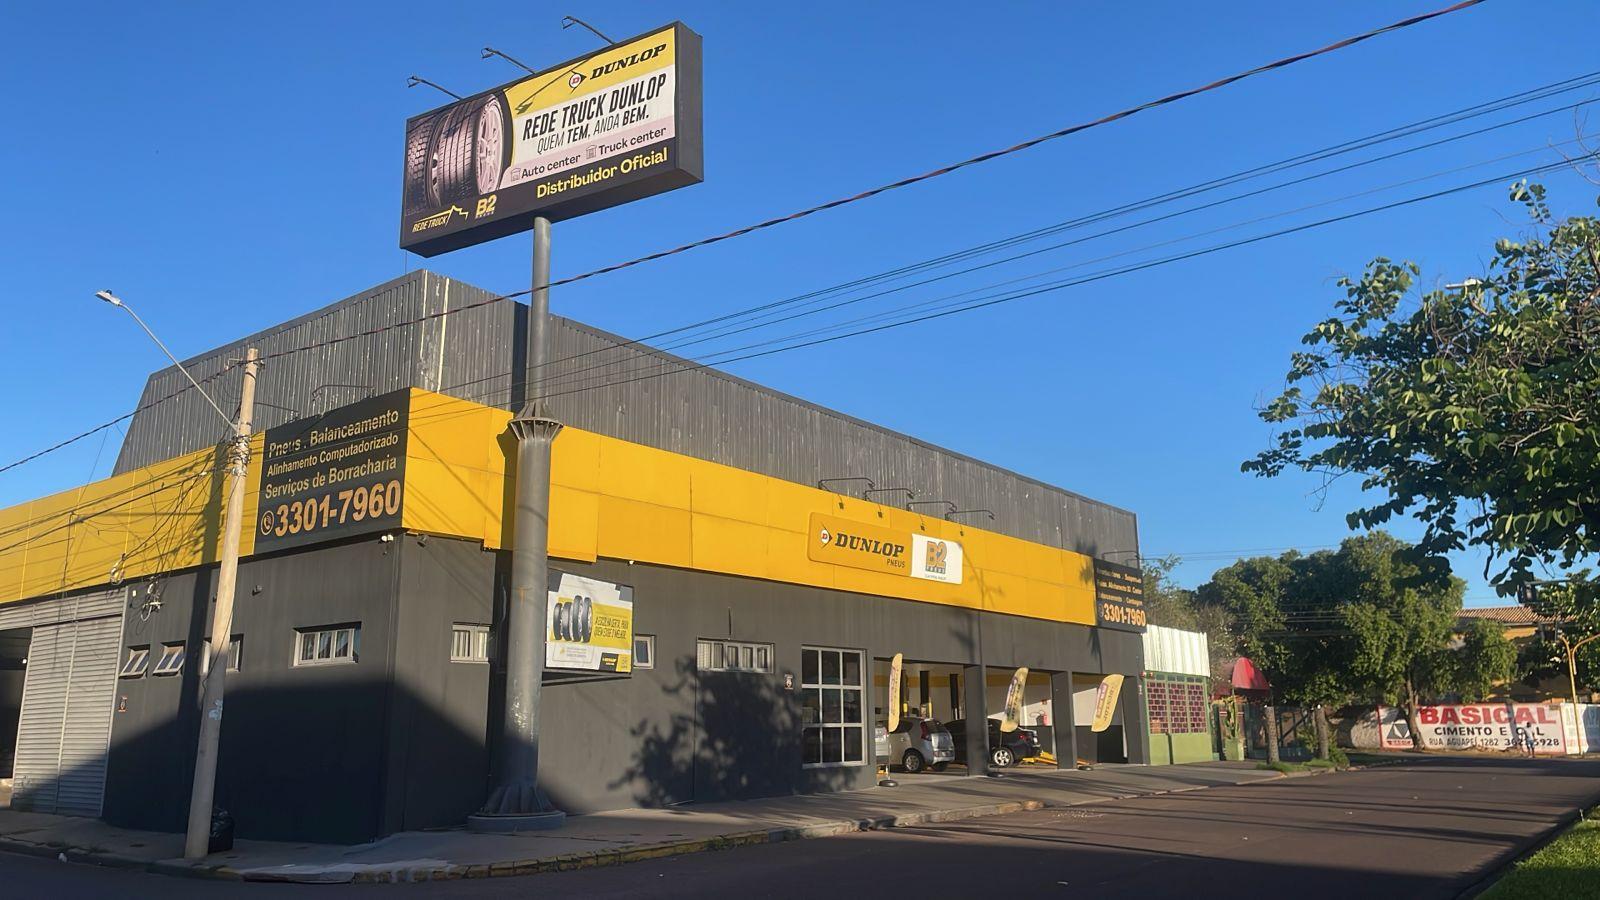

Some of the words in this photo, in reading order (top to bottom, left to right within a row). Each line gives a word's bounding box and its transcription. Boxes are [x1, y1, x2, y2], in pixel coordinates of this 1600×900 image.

[590, 43, 667, 80] DUNLOP
[522, 110, 559, 141] REDE
[561, 94, 607, 129] TRUCK
[609, 73, 667, 113] DUNLOP
[537, 131, 566, 154] QUEM
[593, 115, 620, 135] ANDA
[622, 105, 649, 126] BEM.
[521, 165, 545, 179] Auto
[547, 154, 581, 171] center
[598, 138, 628, 156] Truck
[630, 127, 667, 146] center
[536, 165, 618, 199] Distribuidor
[620, 147, 668, 174] Oficial
[476, 194, 497, 214] B2
[266, 454, 318, 477] Alinhamento
[319, 432, 399, 464] Computadorizado
[265, 477, 309, 499] Serviços
[312, 472, 326, 487] de
[329, 454, 397, 484] Borracharia
[275, 479, 401, 537] 3301-7960
[834, 532, 905, 557] DUNLOP
[926, 540, 948, 567] B2
[886, 558, 906, 568] PNEUS
[1104, 603, 1146, 627] 3301-7960
[1420, 706, 1557, 724] BASICAL
[1434, 726, 1493, 736] CIMENTO
[1500, 726, 1507, 736] E
[1516, 726, 1545, 736] CL
[1429, 737, 1444, 746] RUA
